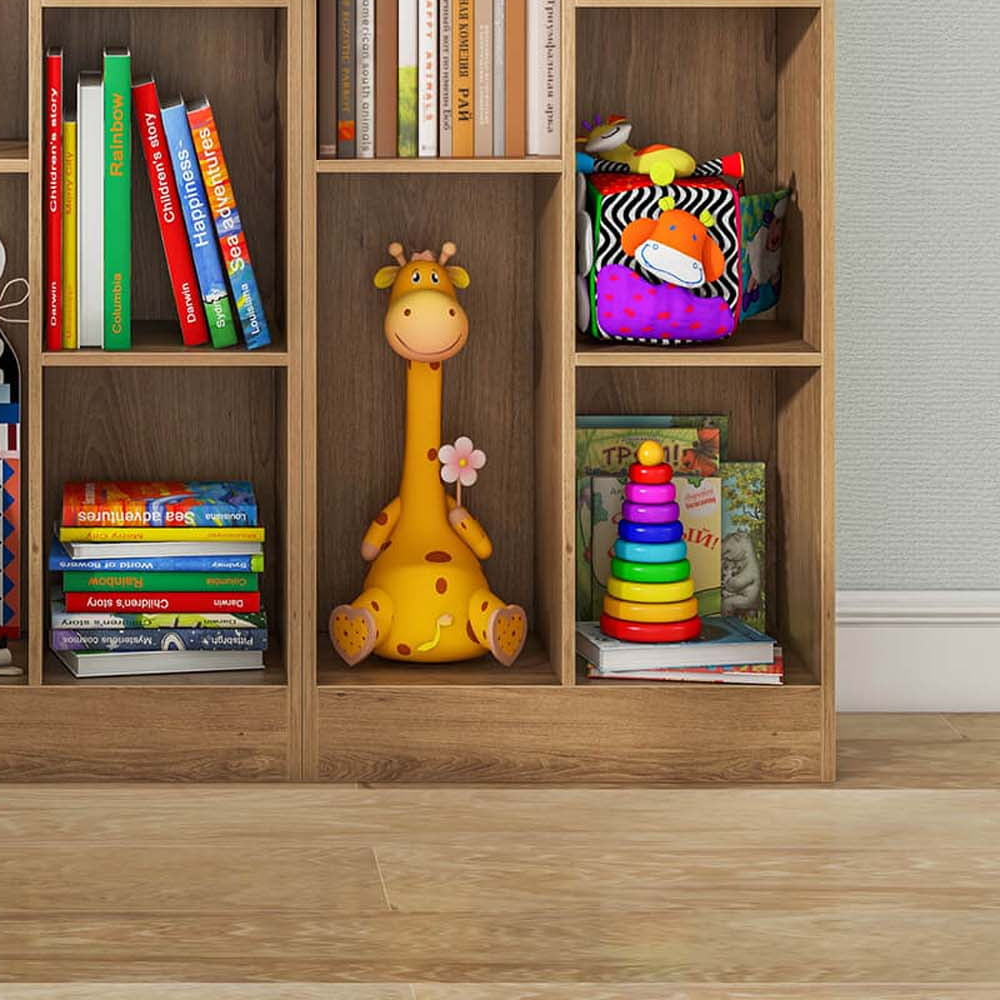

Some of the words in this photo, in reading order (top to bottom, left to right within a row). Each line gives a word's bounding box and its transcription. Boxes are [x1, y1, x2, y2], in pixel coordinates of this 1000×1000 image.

[361, 0, 369, 59] american
[458, 23, 469, 77] КОМЕДИЯ
[361, 63, 370, 98] south
[424, 51, 432, 121] ANIMALS
[50, 87, 58, 127] story
[458, 87, 472, 122] РАЙ
[544, 103, 553, 133] арка
[110, 93, 124, 177] Rainbow
[145, 112, 161, 147] story
[360, 102, 370, 152] animals
[50, 132, 58, 213] Children's
[152, 151, 175, 224] Children's
[199, 127, 235, 230] adventures
[178, 148, 209, 248] Happiness
[229, 235, 245, 271] Sea
[112, 273, 122, 335] Columbia
[181, 282, 197, 324] Darwin
[210, 288, 226, 329] Sydny
[77, 510, 162, 524] adventures
[166, 510, 196, 524] Sea
[59, 560, 102, 569] flowers
[87, 576, 143, 588] Rainbow
[104, 560, 116, 569] of
[119, 560, 153, 569] World
[86, 597, 113, 609] story
[115, 597, 169, 608] Children's
[212, 598, 243, 607] Darwin
[60, 617, 91, 627] story
[203, 618, 236, 626] Darwin
[101, 635, 152, 646] Mysterious
